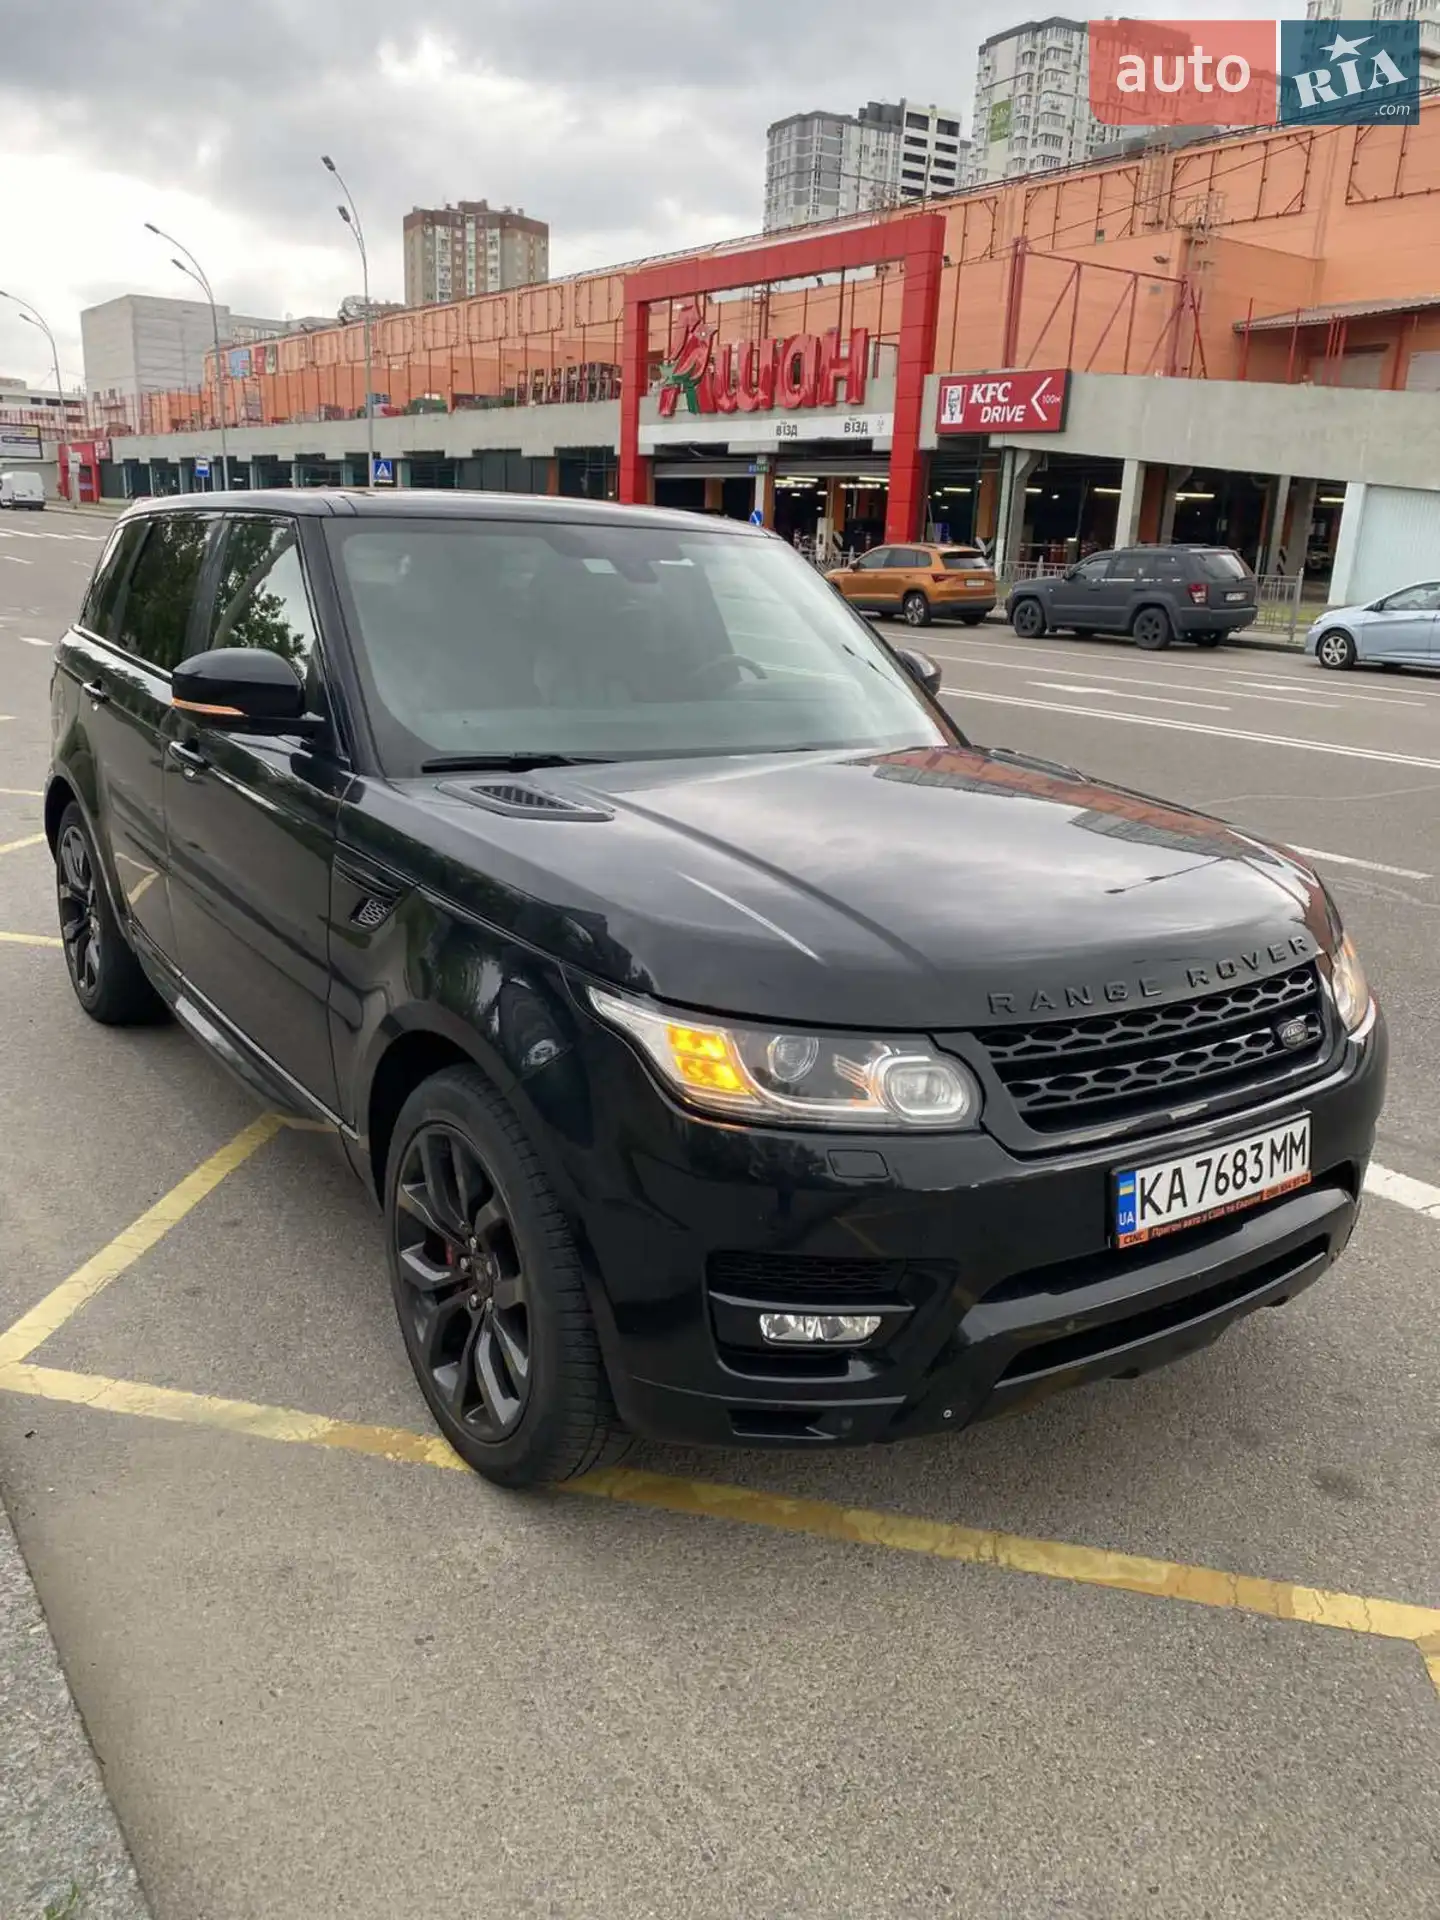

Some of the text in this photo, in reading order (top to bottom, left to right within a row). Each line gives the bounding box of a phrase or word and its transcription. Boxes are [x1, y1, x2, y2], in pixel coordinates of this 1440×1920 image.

[969, 382, 1012, 403] KFC
[980, 405, 1026, 423] DRIVE
[987, 935, 1310, 1014] RANGE ROVER
[1119, 1212, 1135, 1226] UA
